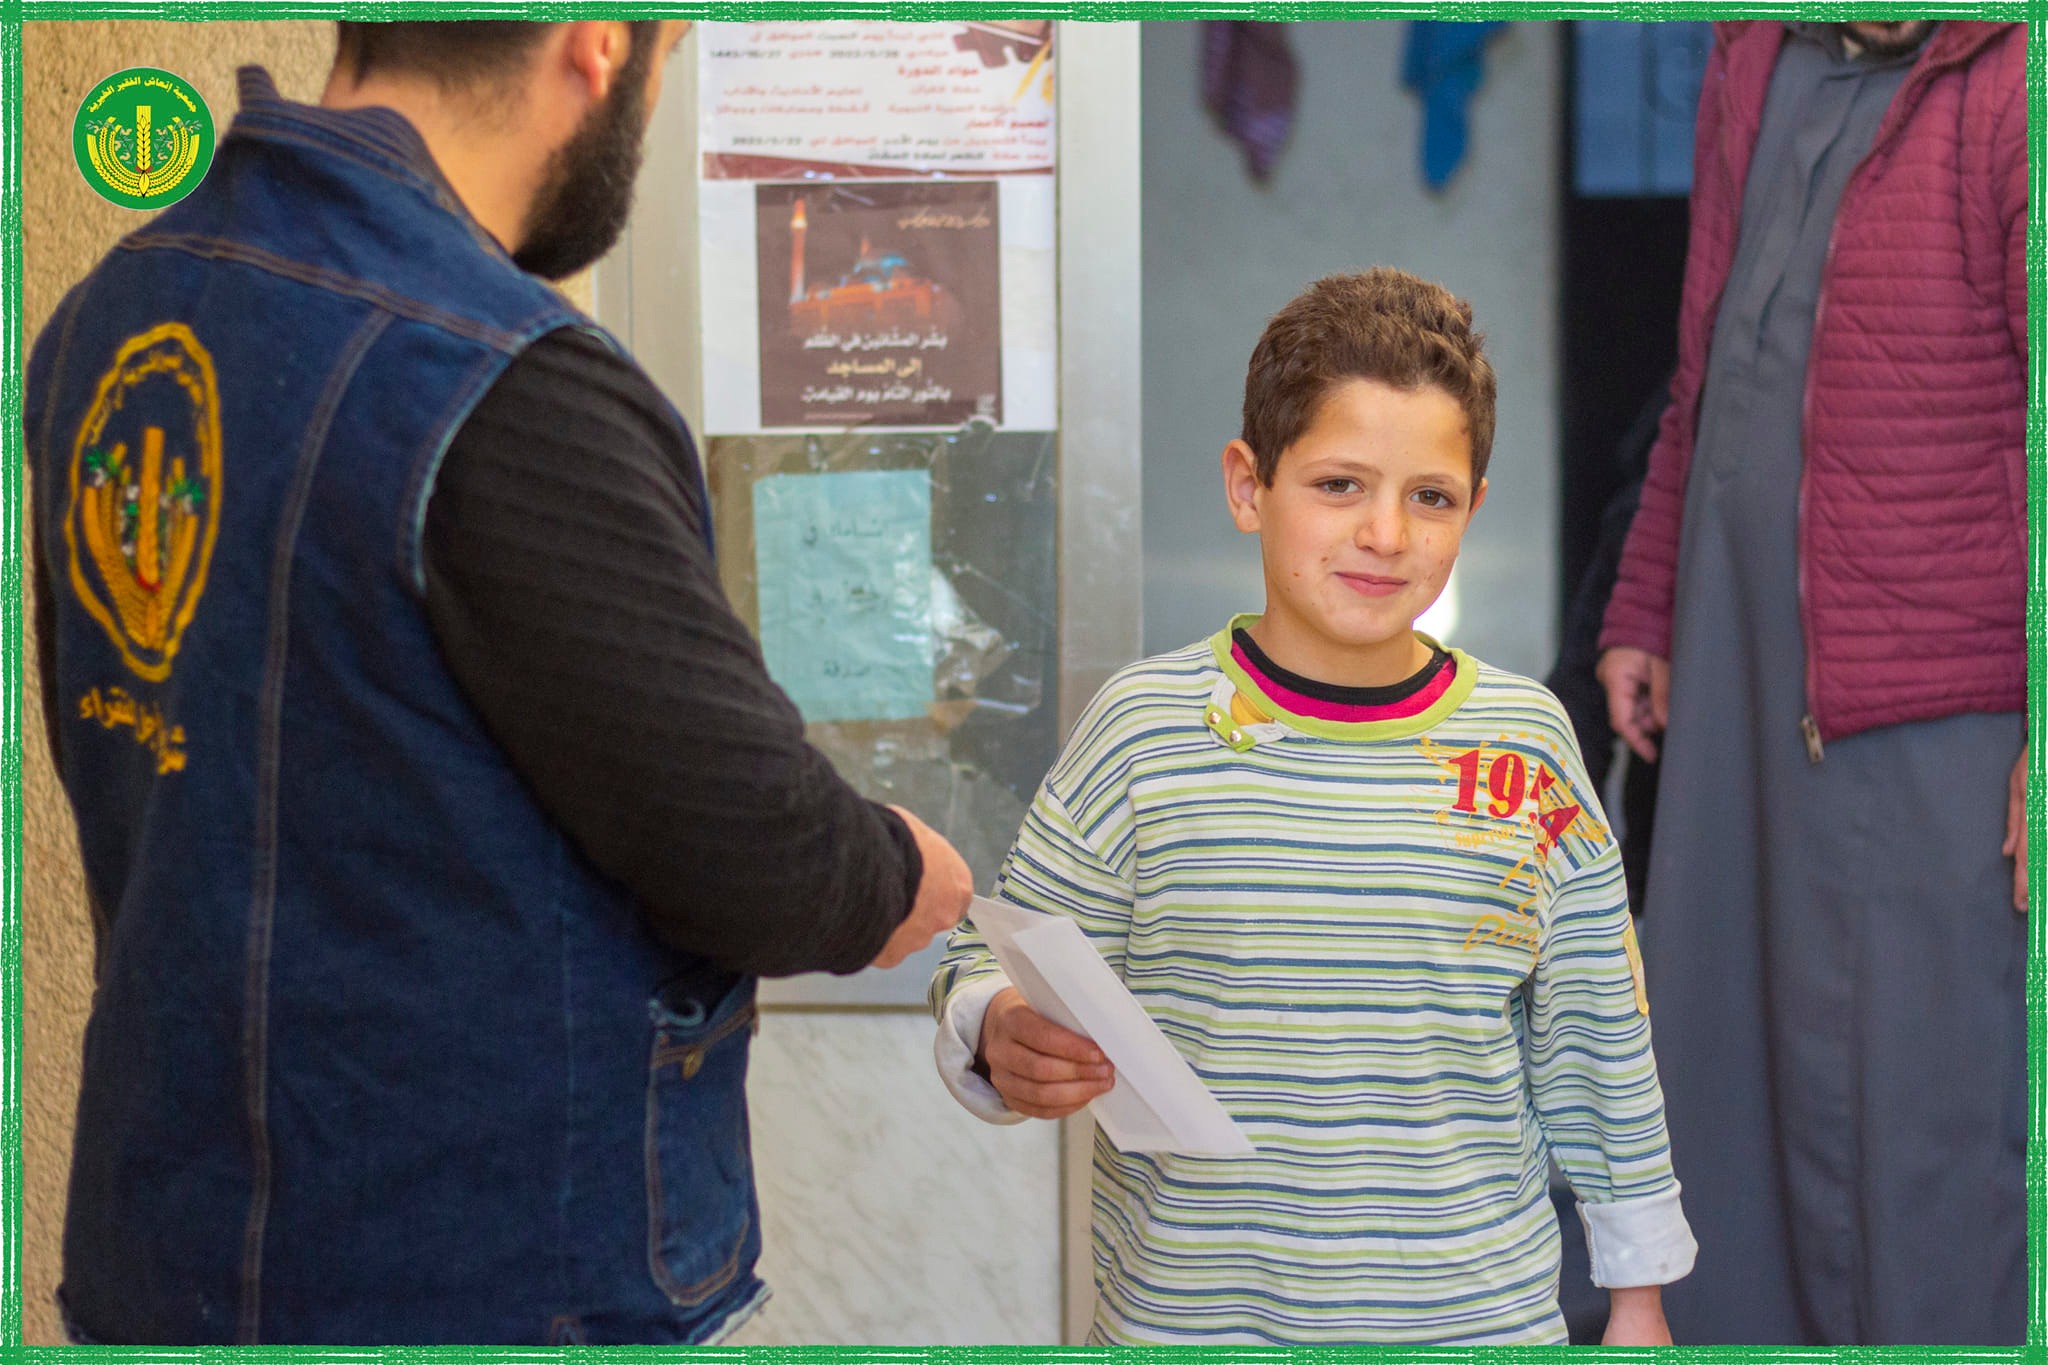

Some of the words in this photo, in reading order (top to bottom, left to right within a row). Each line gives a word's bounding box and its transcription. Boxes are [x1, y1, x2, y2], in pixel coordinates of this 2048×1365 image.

[840, 333, 861, 352] في
[827, 357, 896, 378] المساجد
[896, 357, 922, 378] إلى
[855, 388, 881, 403] يوم
